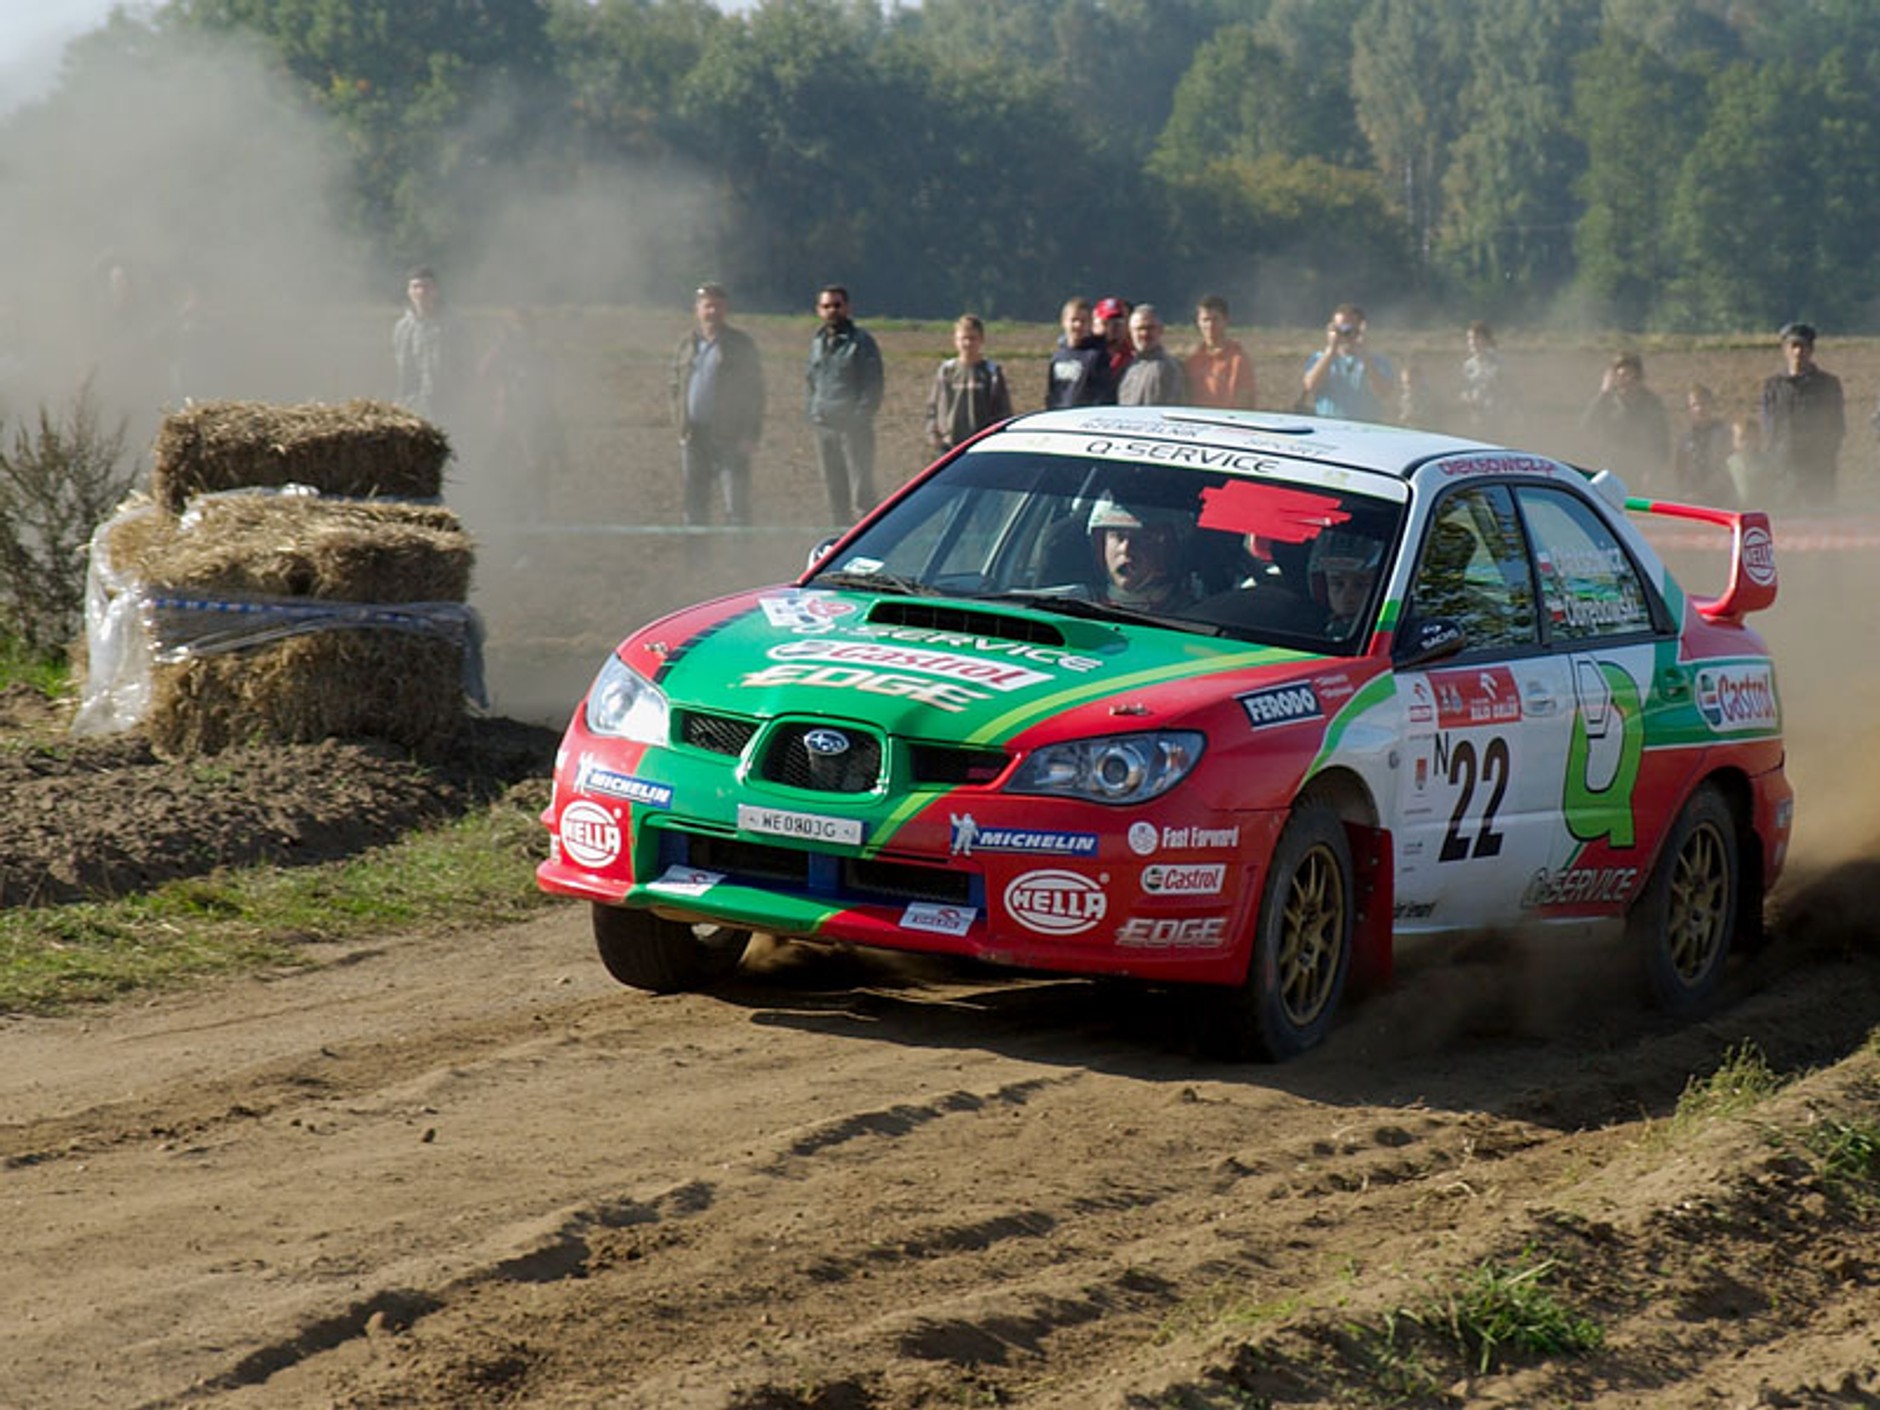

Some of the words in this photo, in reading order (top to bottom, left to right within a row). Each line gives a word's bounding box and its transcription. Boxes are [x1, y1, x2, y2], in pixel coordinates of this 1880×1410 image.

[828, 645, 1026, 687] Castrol
[740, 664, 995, 713] EDGE
[1718, 671, 1776, 722] Castrol
[1243, 689, 1317, 723] FERODO
[1434, 732, 1449, 776] N
[590, 773, 670, 802] MICHELIN
[1438, 736, 1511, 863] 22
[979, 831, 1096, 851] MICHELIN
[1162, 827, 1188, 849] Fast
[1190, 824, 1240, 848] Forward
[1164, 868, 1219, 889] Castrol
[1013, 890, 1107, 920] HELLA
[1115, 918, 1228, 947] EDGE
